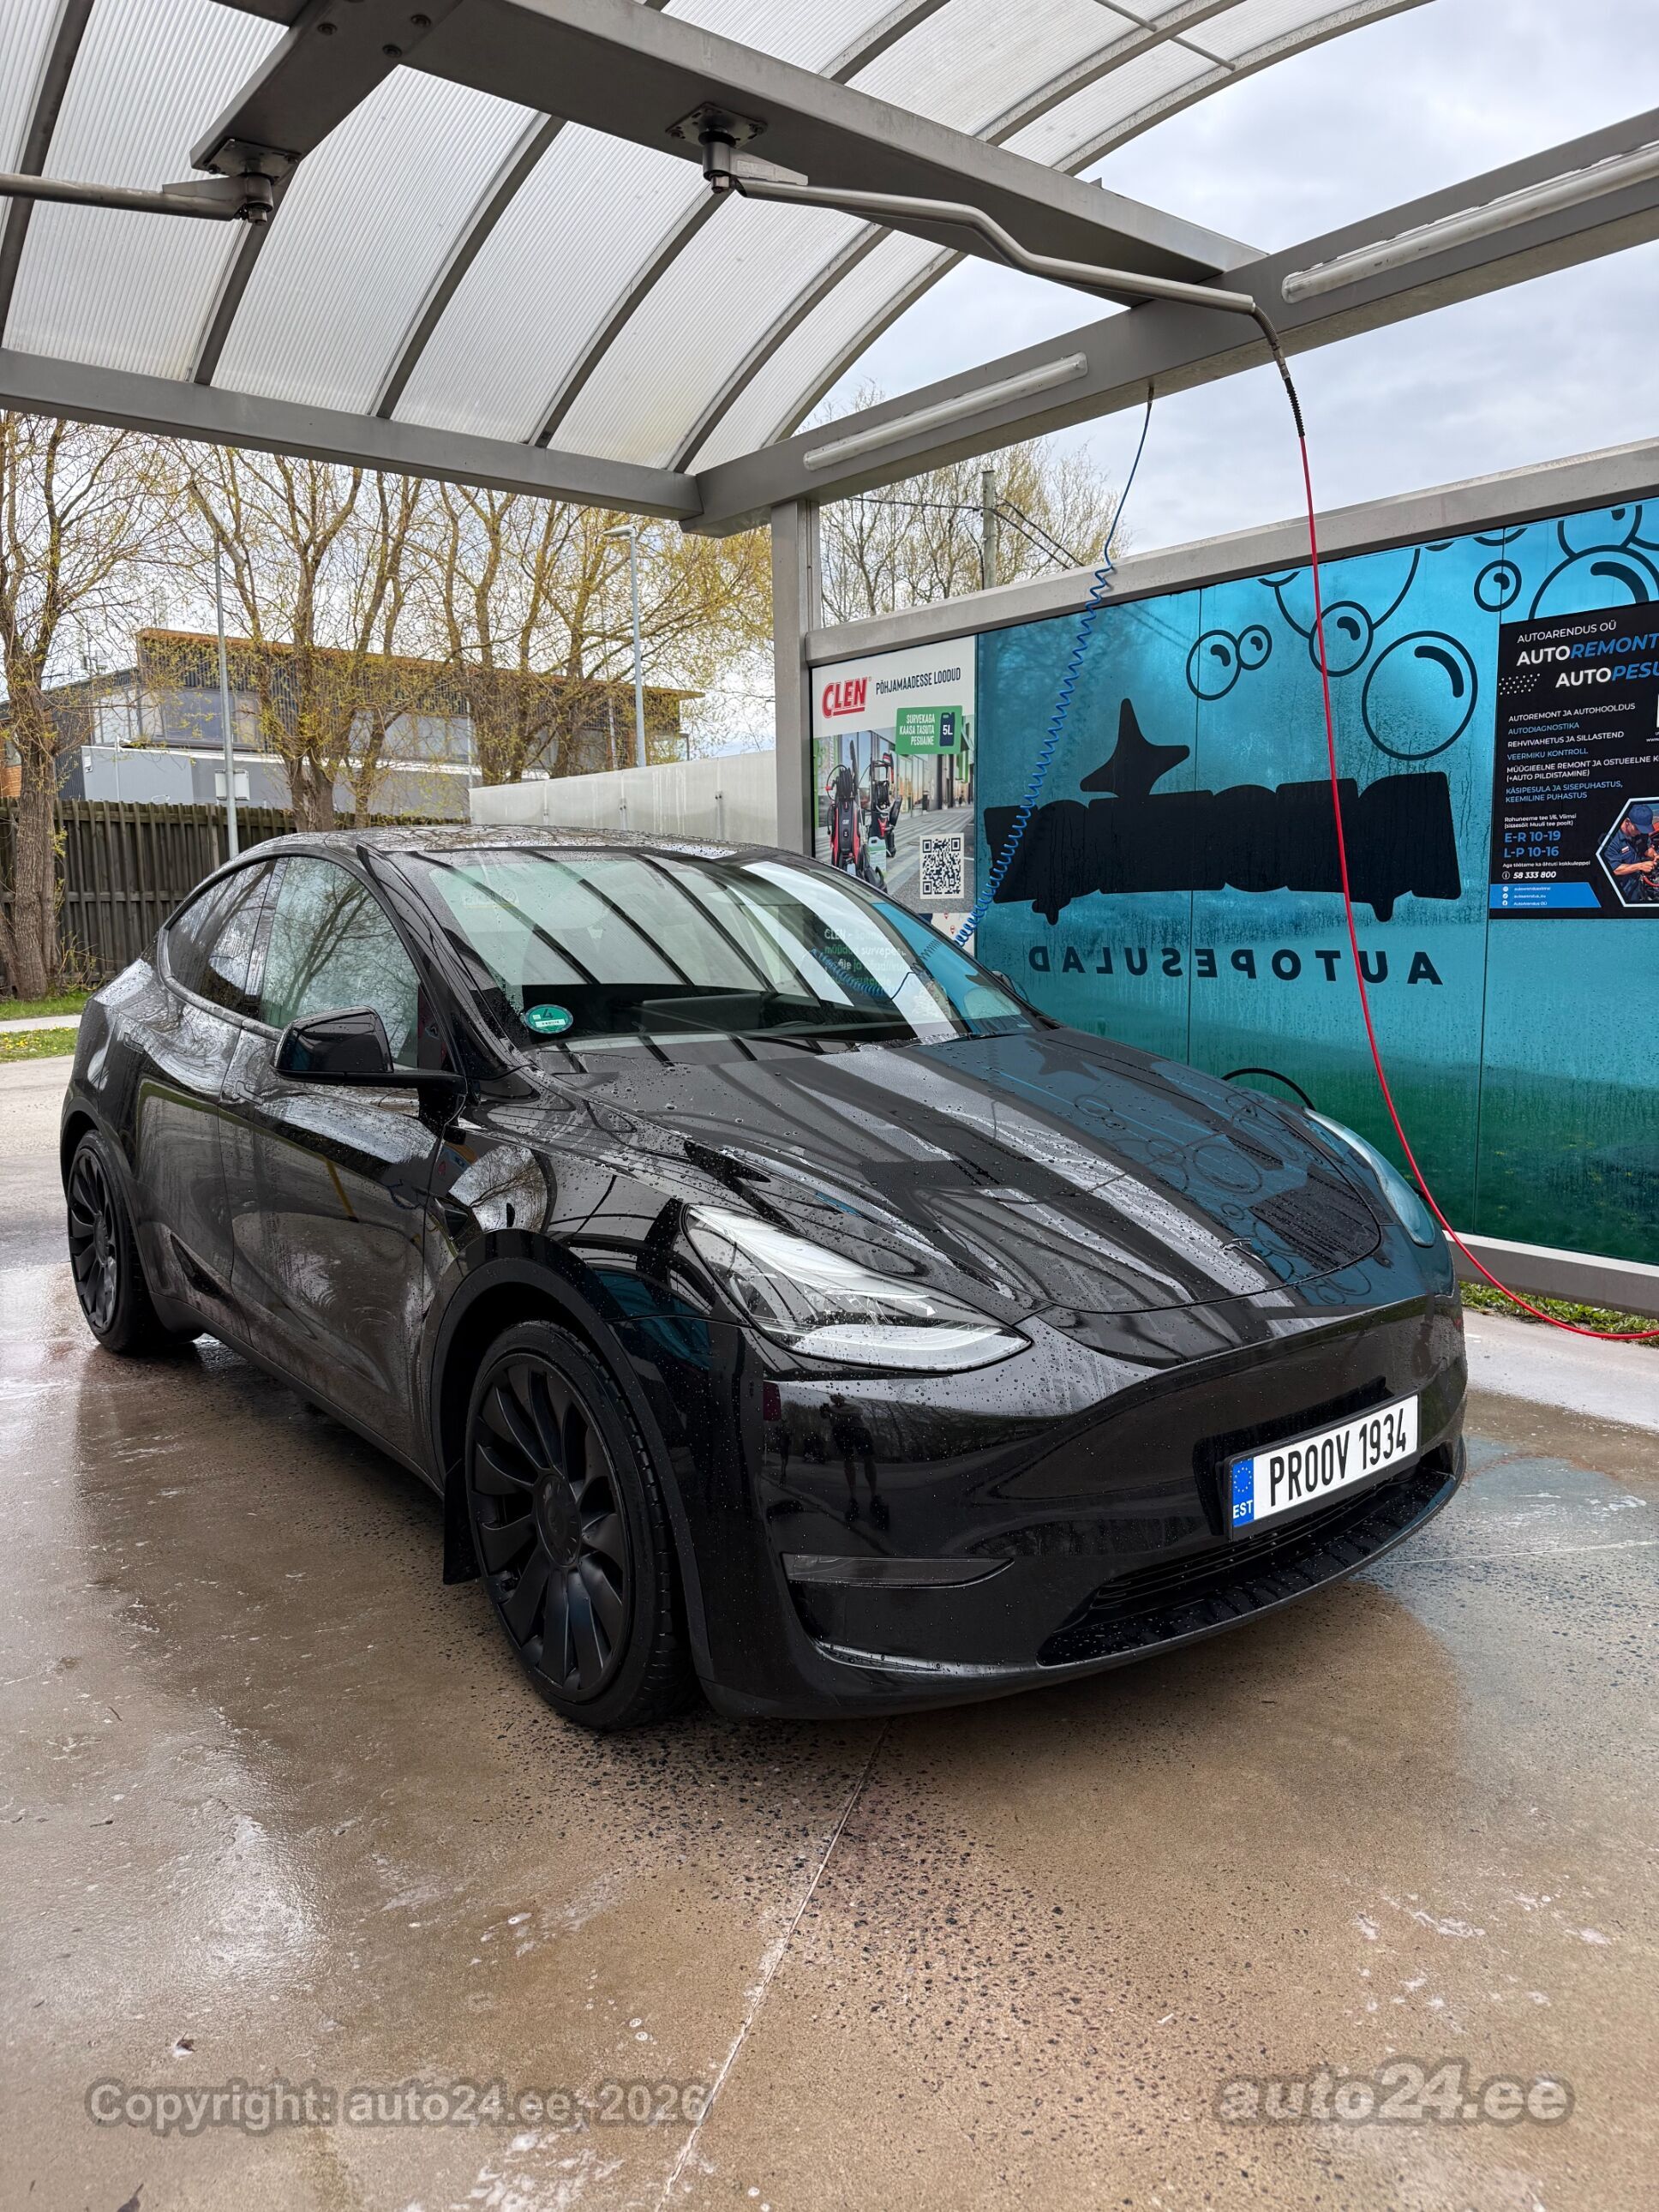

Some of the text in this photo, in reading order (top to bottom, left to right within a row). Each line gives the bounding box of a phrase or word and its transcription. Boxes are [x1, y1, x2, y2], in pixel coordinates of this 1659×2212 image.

[1518, 620, 1616, 643] AUTOARENDUS OÜ
[1517, 632, 1659, 666] AUTOREMONT
[876, 667, 961, 695] PÕHJAMAADESSE LOODUD
[821, 675, 869, 719] CLEN
[907, 713, 935, 725] SURVEKAGA
[1508, 710, 1560, 722] AUTOREMONT
[1573, 703, 1635, 716] AUTOHOOLDUS
[900, 725, 934, 734] KAASA TASUTA
[943, 724, 953, 735] 5L
[1508, 722, 1580, 735] AUTODIAGNOSTIKA
[911, 735, 934, 746] PESUAINE
[1508, 736, 1564, 747] REHVIVAHETUS
[1577, 731, 1625, 742] SILLASTEND
[1506, 748, 1589, 761] VEERMIKU KONTROLL
[1506, 761, 1555, 773] MÜÜGIEELNE
[1558, 760, 1590, 770] REMONT
[1604, 756, 1650, 766] OSTUEELNE
[1534, 770, 1590, 781] PILDISTAMINE)
[1506, 785, 1551, 795] KÄSIPESULA
[1563, 780, 1623, 791] SISEPUHASTUS,
[1505, 792, 1587, 803] KEEMILINE PUHASTUS
[1505, 830, 1561, 843] E-R 10-19
[1504, 847, 1560, 858] L-P 10-16
[1524, 871, 1539, 879] 333
[542, 1008, 554, 1018] 4
[1270, 1408, 1406, 1508] PROOV 1934
[1233, 1500, 1253, 1519] EST
